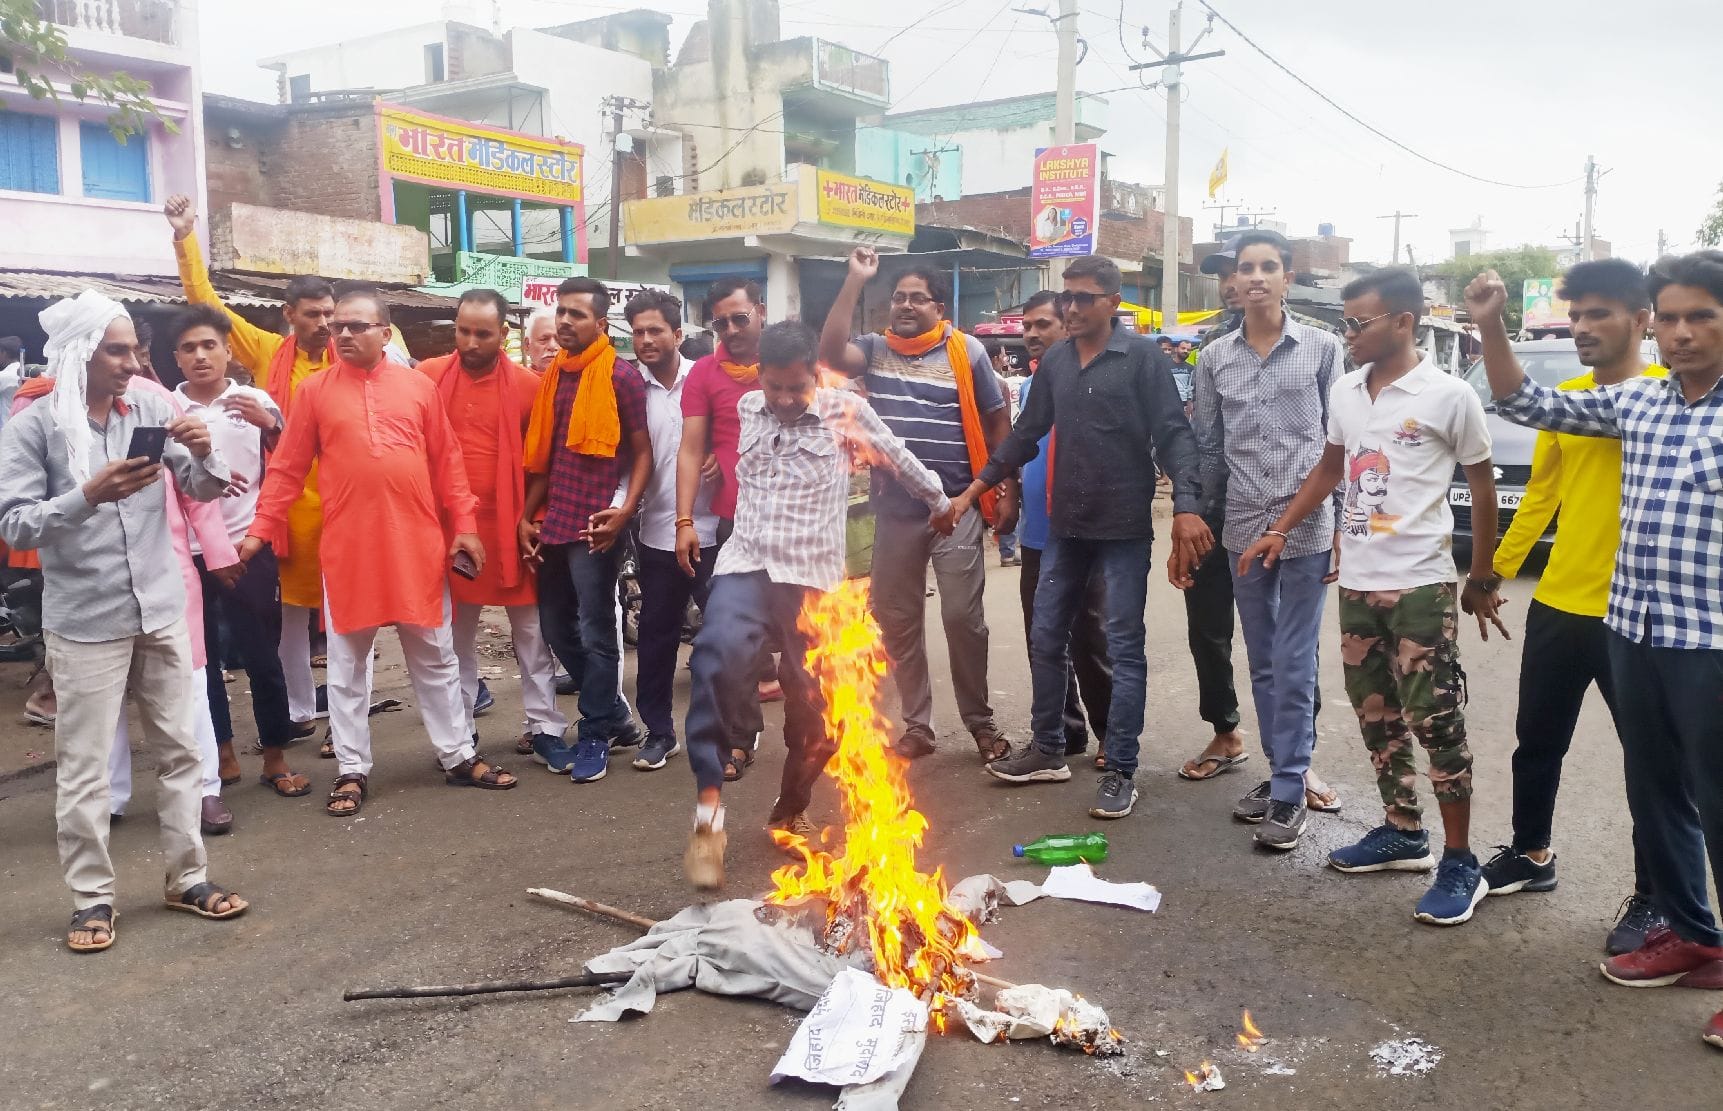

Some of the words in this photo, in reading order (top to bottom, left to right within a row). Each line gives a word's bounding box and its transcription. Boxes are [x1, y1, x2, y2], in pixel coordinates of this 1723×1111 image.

[398, 127, 465, 164] भारत
[1039, 158, 1089, 171] LAKSHYA
[1039, 169, 1089, 181] INSTITUTE
[833, 181, 858, 204] भारत
[1453, 490, 1471, 502] UP2
[1501, 495, 1523, 505] 667
[869, 988, 893, 1029] जिहाद
[804, 1026, 823, 1071] जिहाद
